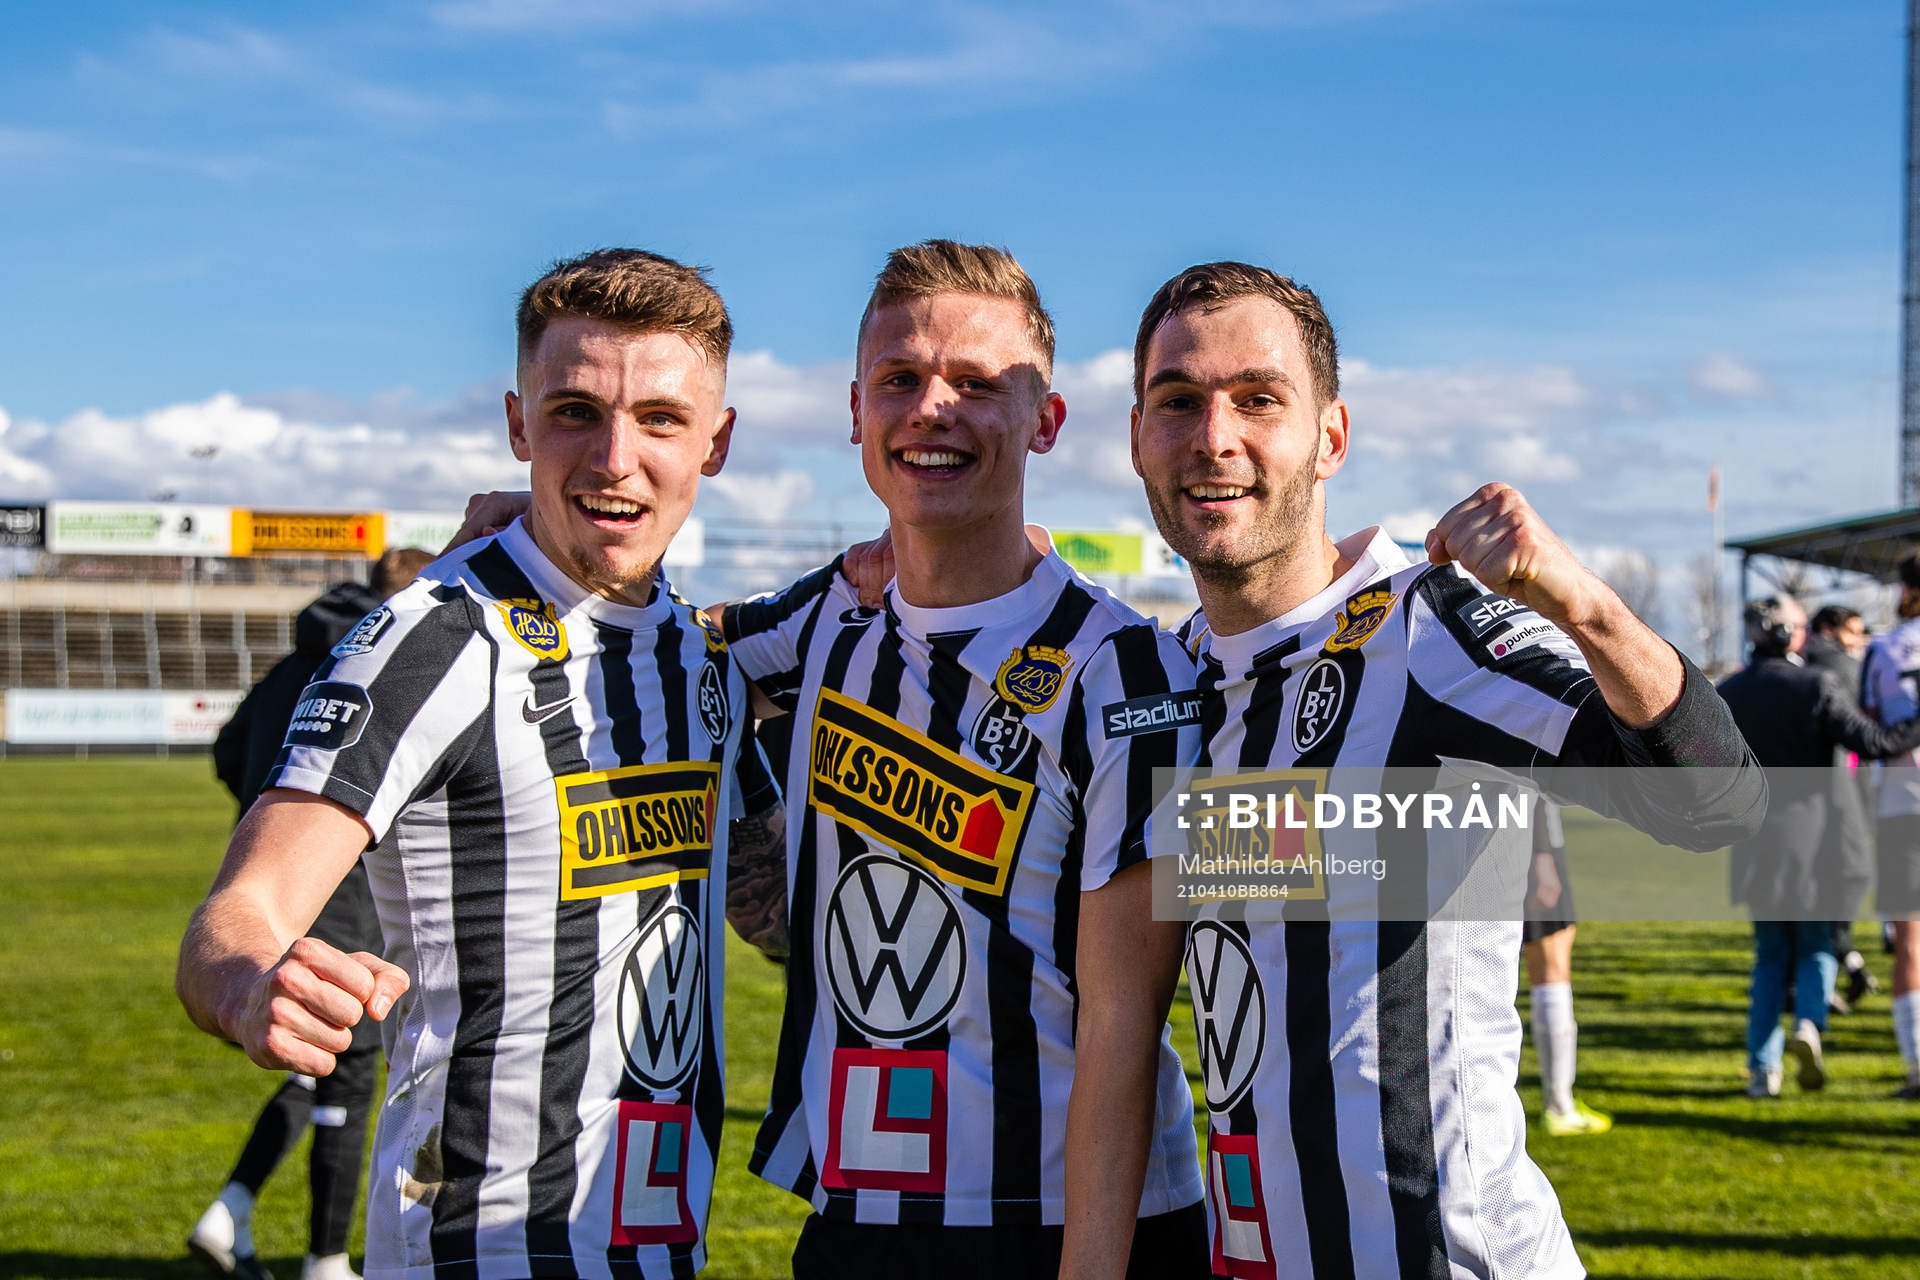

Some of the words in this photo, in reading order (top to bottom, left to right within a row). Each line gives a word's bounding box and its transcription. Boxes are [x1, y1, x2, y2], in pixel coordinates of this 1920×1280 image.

[1505, 624, 1554, 649] punktum
[295, 698, 361, 723] NIBET
[814, 724, 965, 843] OHLSSONS
[576, 796, 706, 861] OHLSSONS
